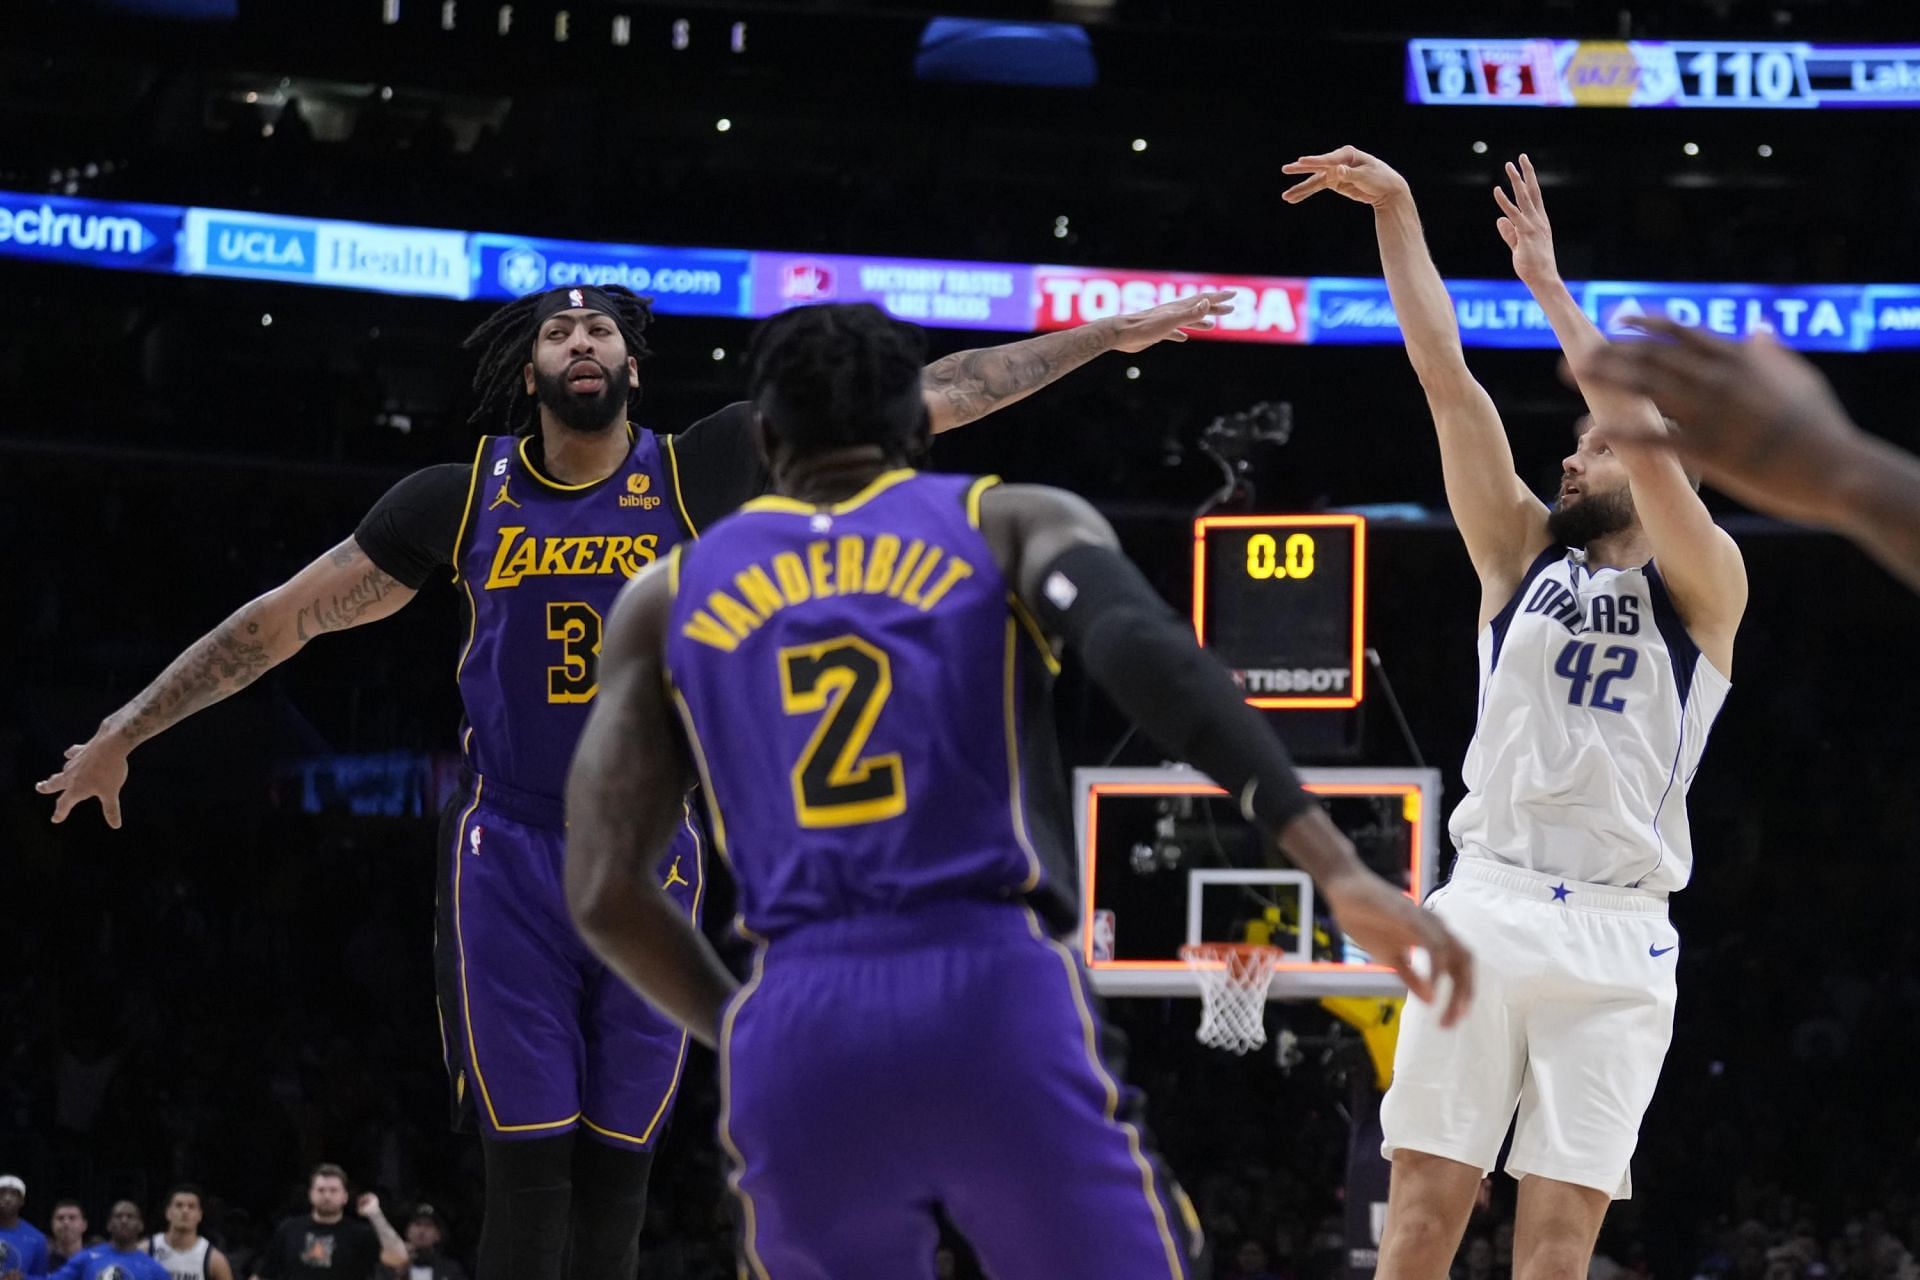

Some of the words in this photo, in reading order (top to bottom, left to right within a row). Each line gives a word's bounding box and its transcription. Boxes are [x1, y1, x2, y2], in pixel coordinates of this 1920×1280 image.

[1688, 50, 1795, 100] 110
[218, 229, 305, 267] UCLA
[330, 239, 452, 280] Health
[548, 260, 721, 297] crypto.com
[1045, 278, 1295, 333] TOSBA
[1665, 297, 1845, 337] DELTA
[493, 458, 508, 476] 6
[619, 495, 661, 510] bibigo
[484, 526, 658, 590] LAKERS
[1247, 533, 1314, 579] 0.0
[683, 534, 973, 653] VANDERBILT
[546, 602, 602, 704] 3
[1554, 639, 1639, 714] 42
[1246, 669, 1350, 692] TISSOT
[778, 633, 907, 829] 2
